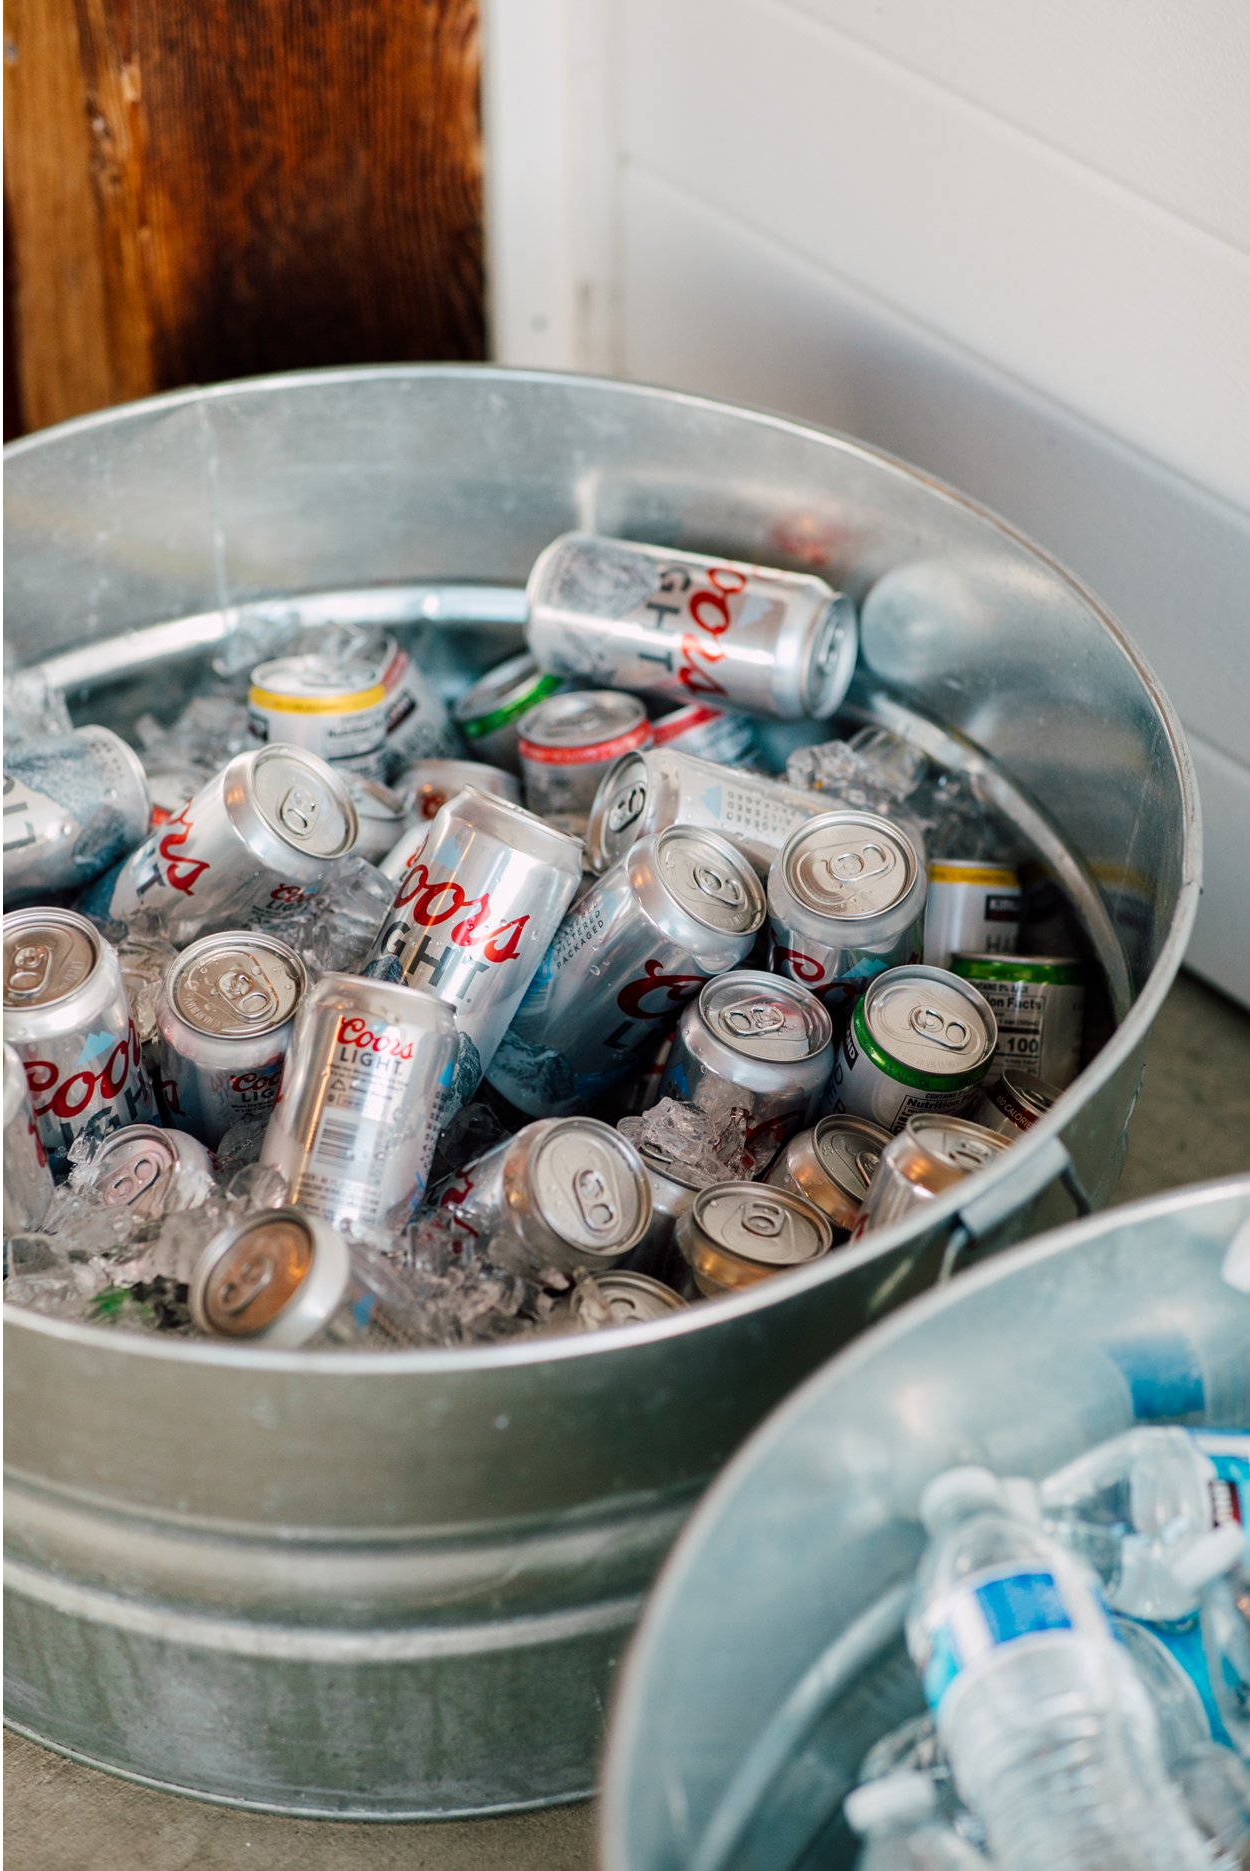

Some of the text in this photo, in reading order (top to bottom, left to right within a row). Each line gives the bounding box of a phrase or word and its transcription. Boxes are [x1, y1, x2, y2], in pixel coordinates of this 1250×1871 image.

[638, 566, 692, 673] GHT
[678, 568, 748, 697] oors
[393, 864, 531, 963] oors
[556, 920, 604, 971] PACKAGED
[337, 1014, 415, 1060] Coors
[1007, 1037, 1039, 1053] 100
[339, 1047, 403, 1077] LIGHT
[241, 1088, 274, 1102] LIG
[907, 1098, 960, 1110] Nutrition
[1004, 1103, 1034, 1131] CALORIE
